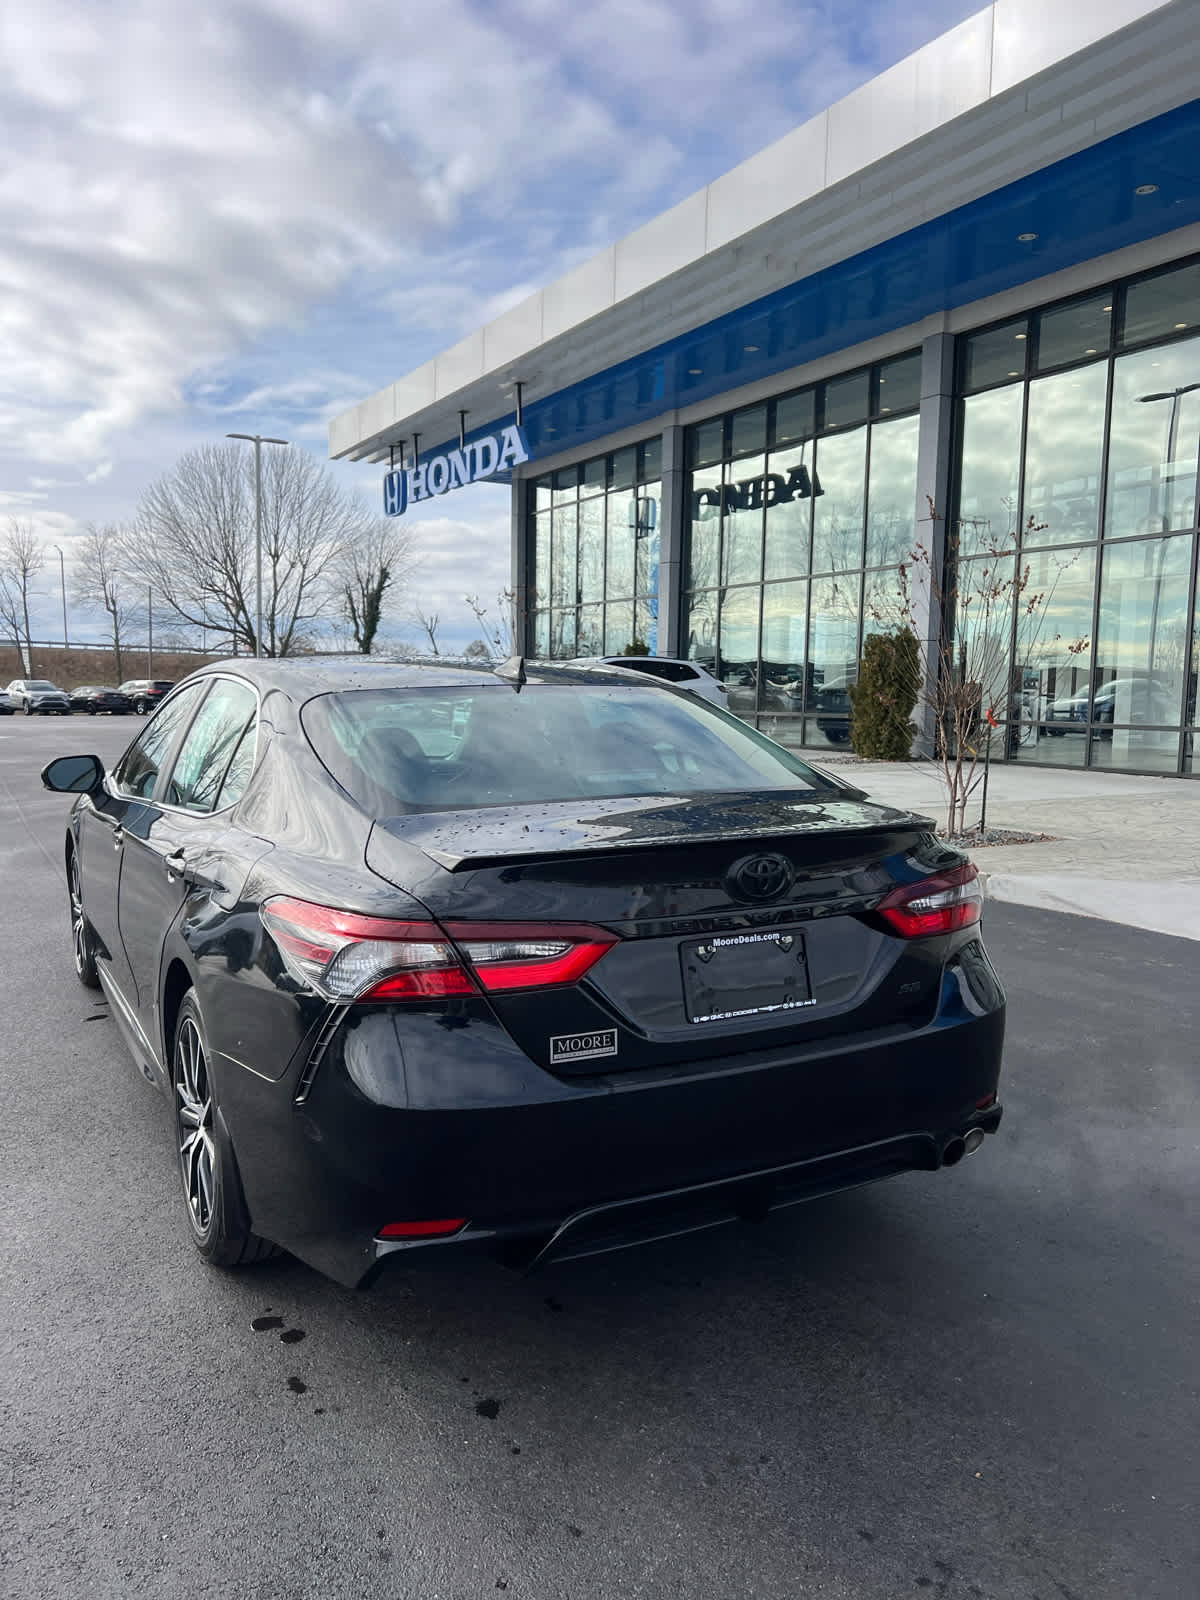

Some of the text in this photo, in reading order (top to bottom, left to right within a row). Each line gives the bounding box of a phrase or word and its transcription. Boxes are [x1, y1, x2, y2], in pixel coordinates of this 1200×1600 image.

[406, 424, 530, 503] HONDA
[712, 933, 780, 947] MooreDeals.com
[557, 1034, 612, 1053] MOORE
